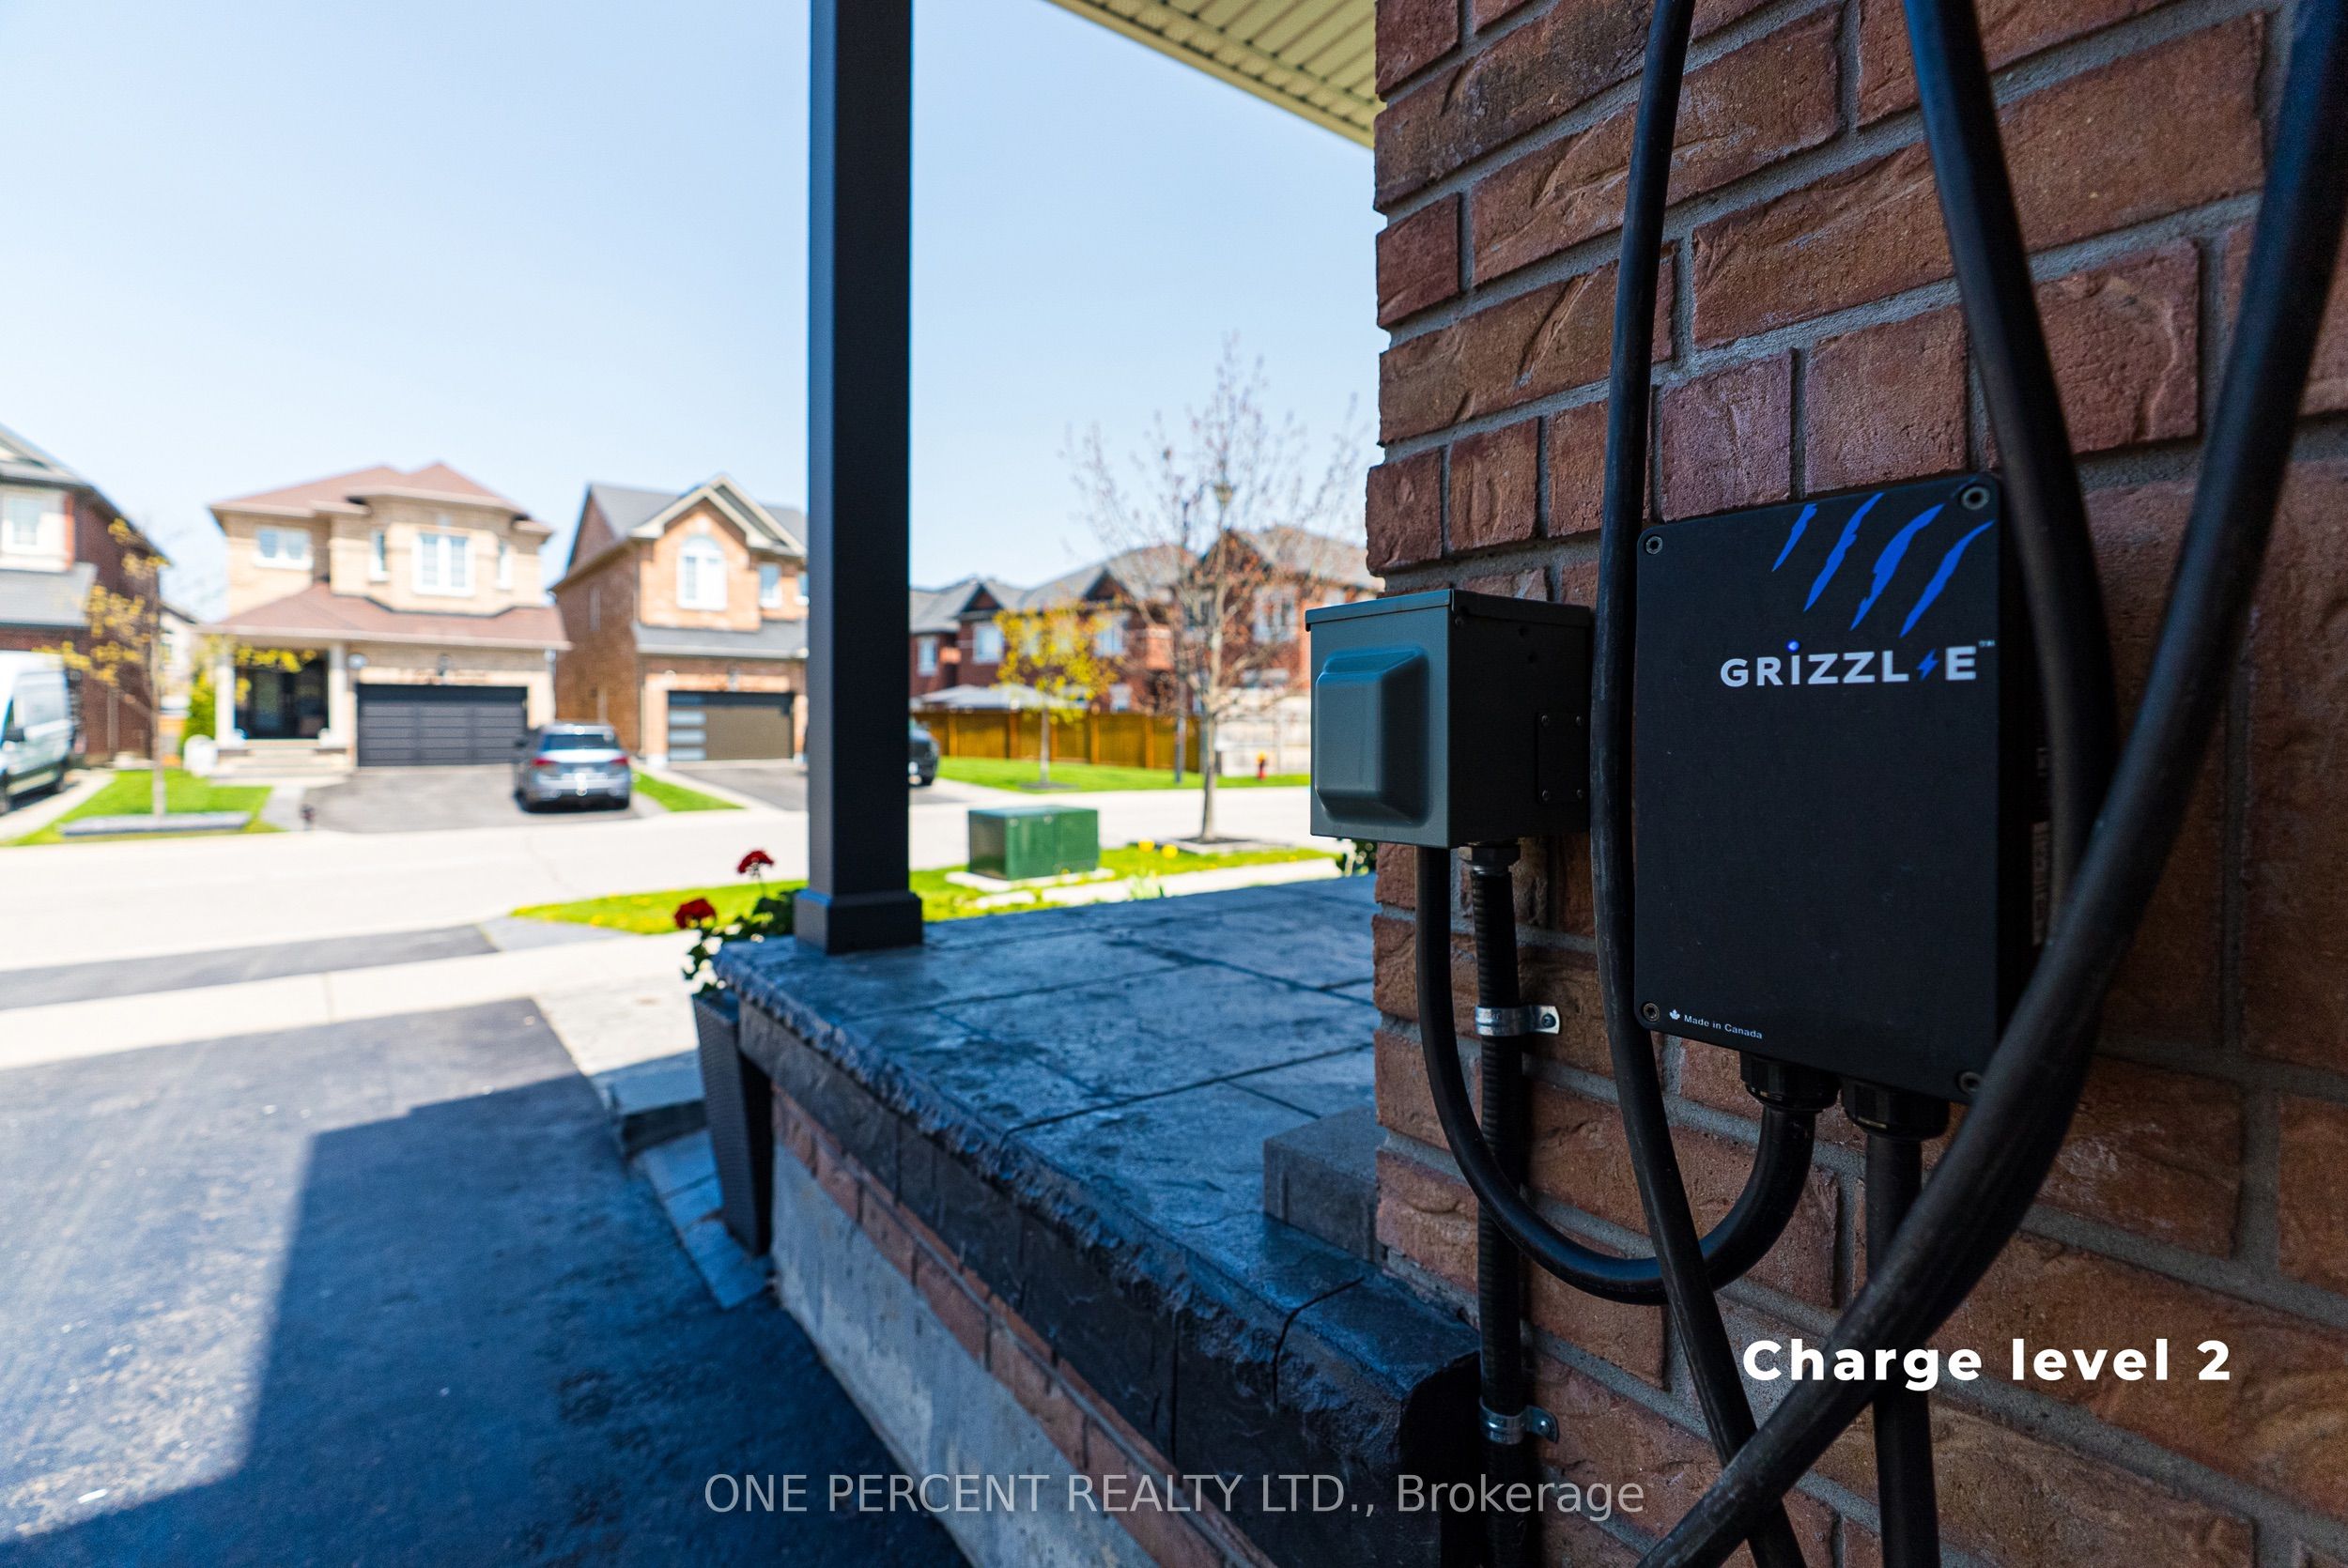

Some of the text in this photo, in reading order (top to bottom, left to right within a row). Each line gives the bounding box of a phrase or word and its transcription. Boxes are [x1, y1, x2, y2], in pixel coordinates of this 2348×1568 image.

[1684, 1014, 1763, 1039] Made in Canada
